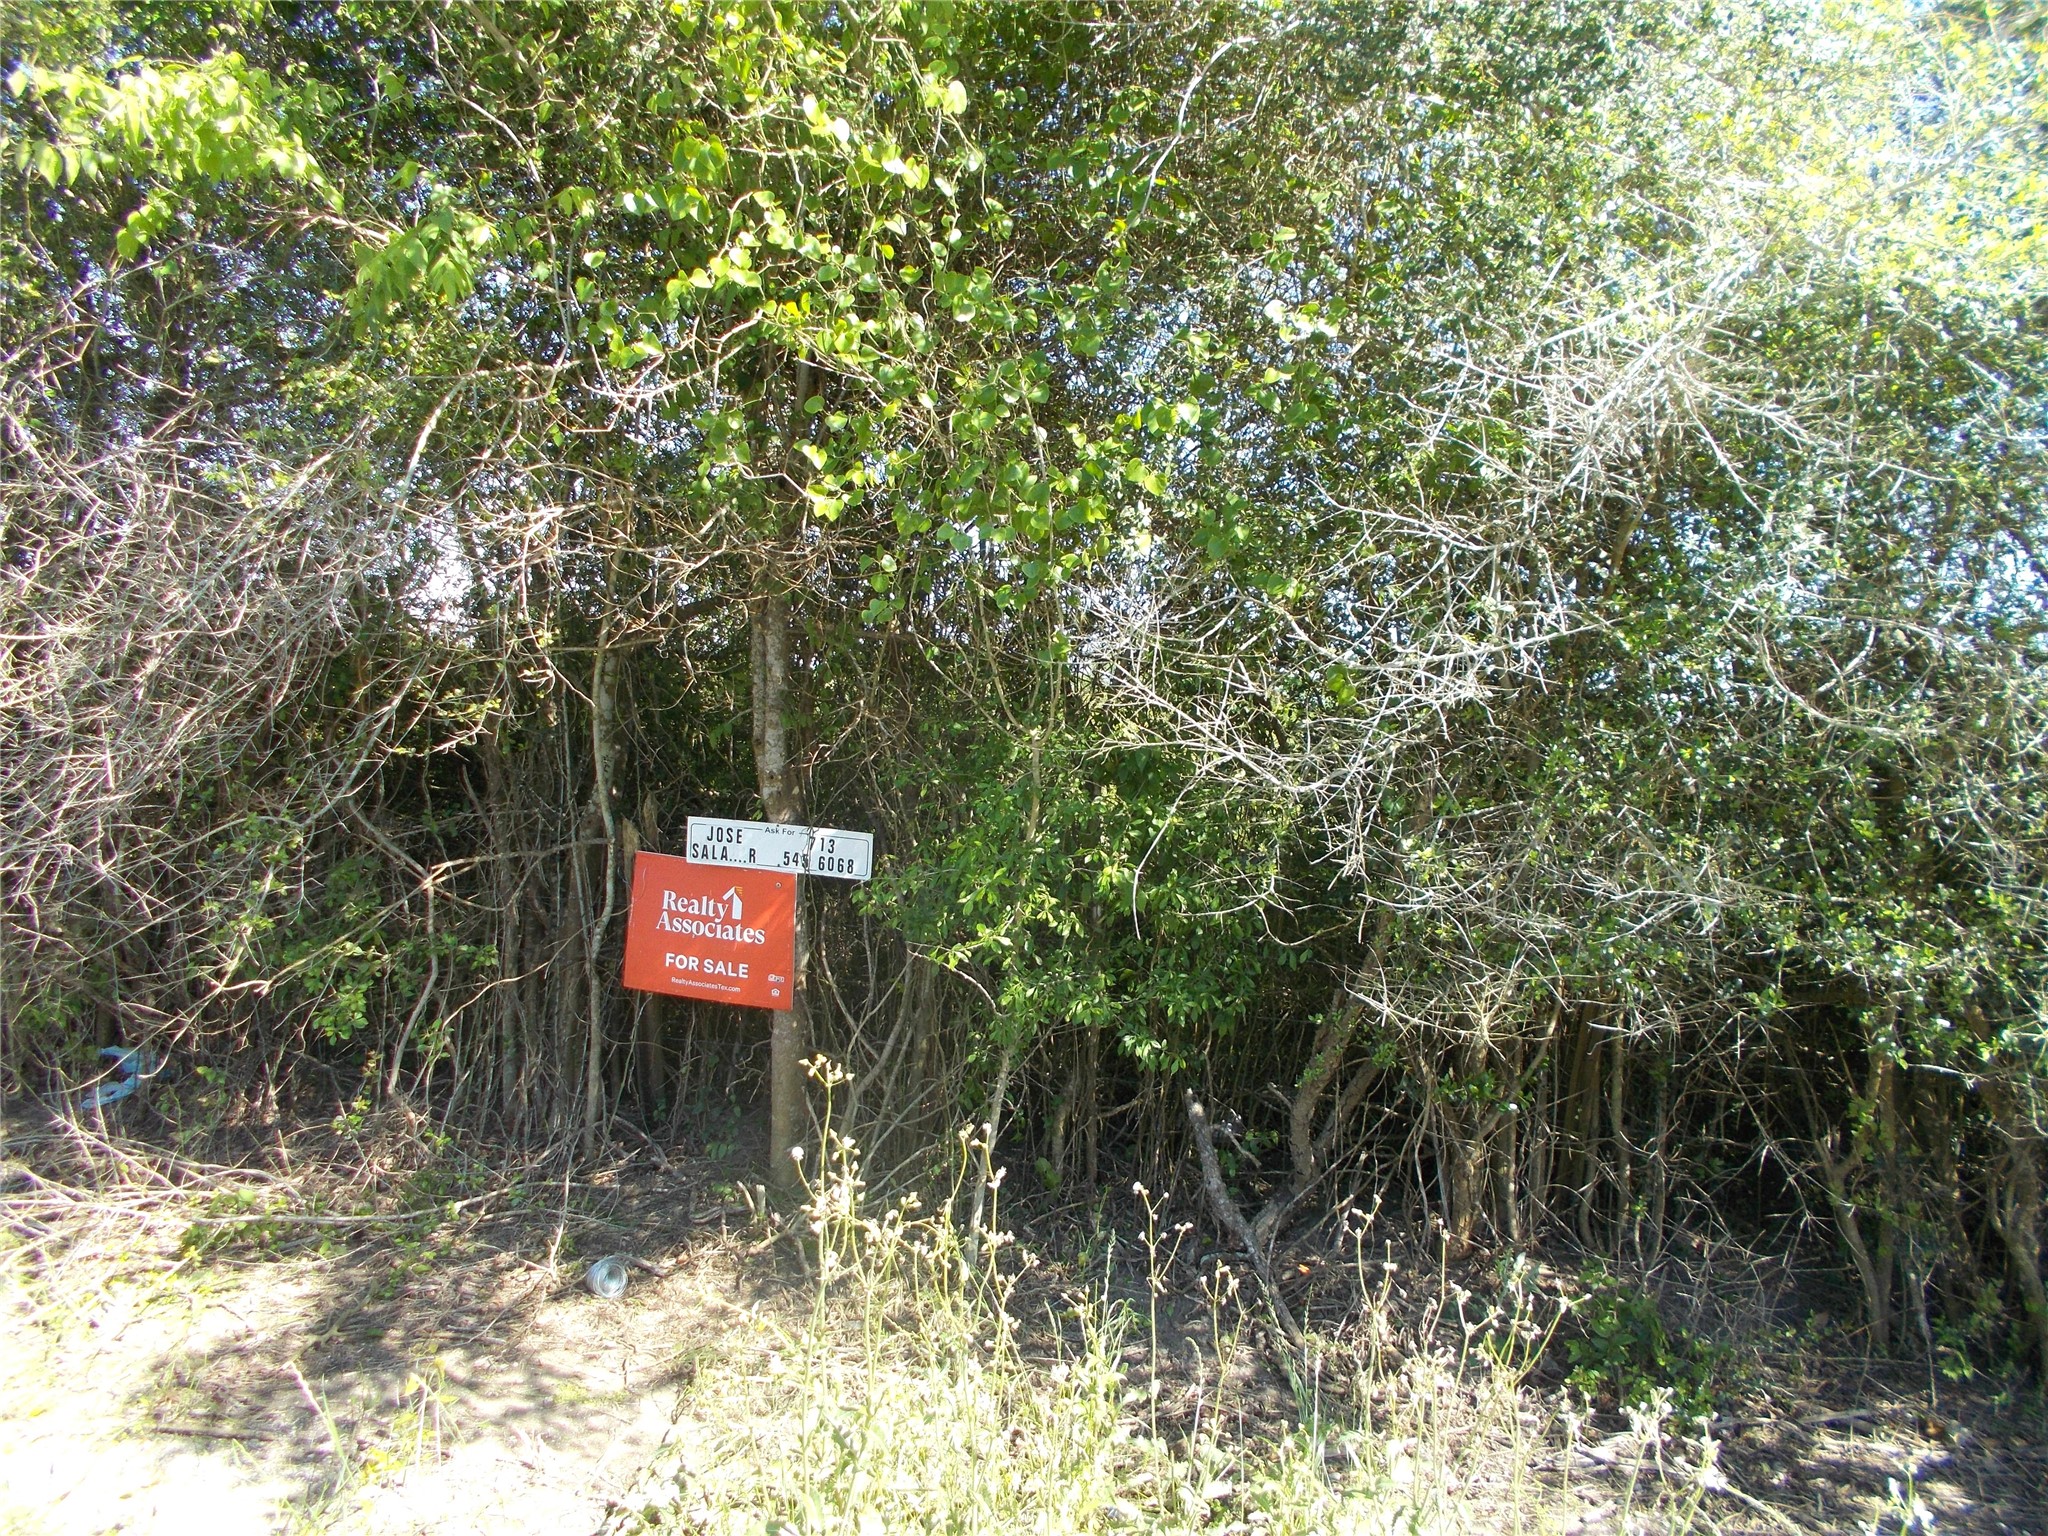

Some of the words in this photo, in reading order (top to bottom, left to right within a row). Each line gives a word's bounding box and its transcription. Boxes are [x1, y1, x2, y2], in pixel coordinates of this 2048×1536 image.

[707, 826, 743, 844] JOSE
[765, 826, 780, 835] Ask
[782, 828, 795, 836] For
[818, 856, 854, 874] 6068
[662, 890, 729, 923] Realty
[655, 910, 765, 945] Associates
[665, 952, 699, 971] FOR
[703, 958, 749, 978] SALE
[671, 976, 741, 993] RealtyAssociatesTex.com
